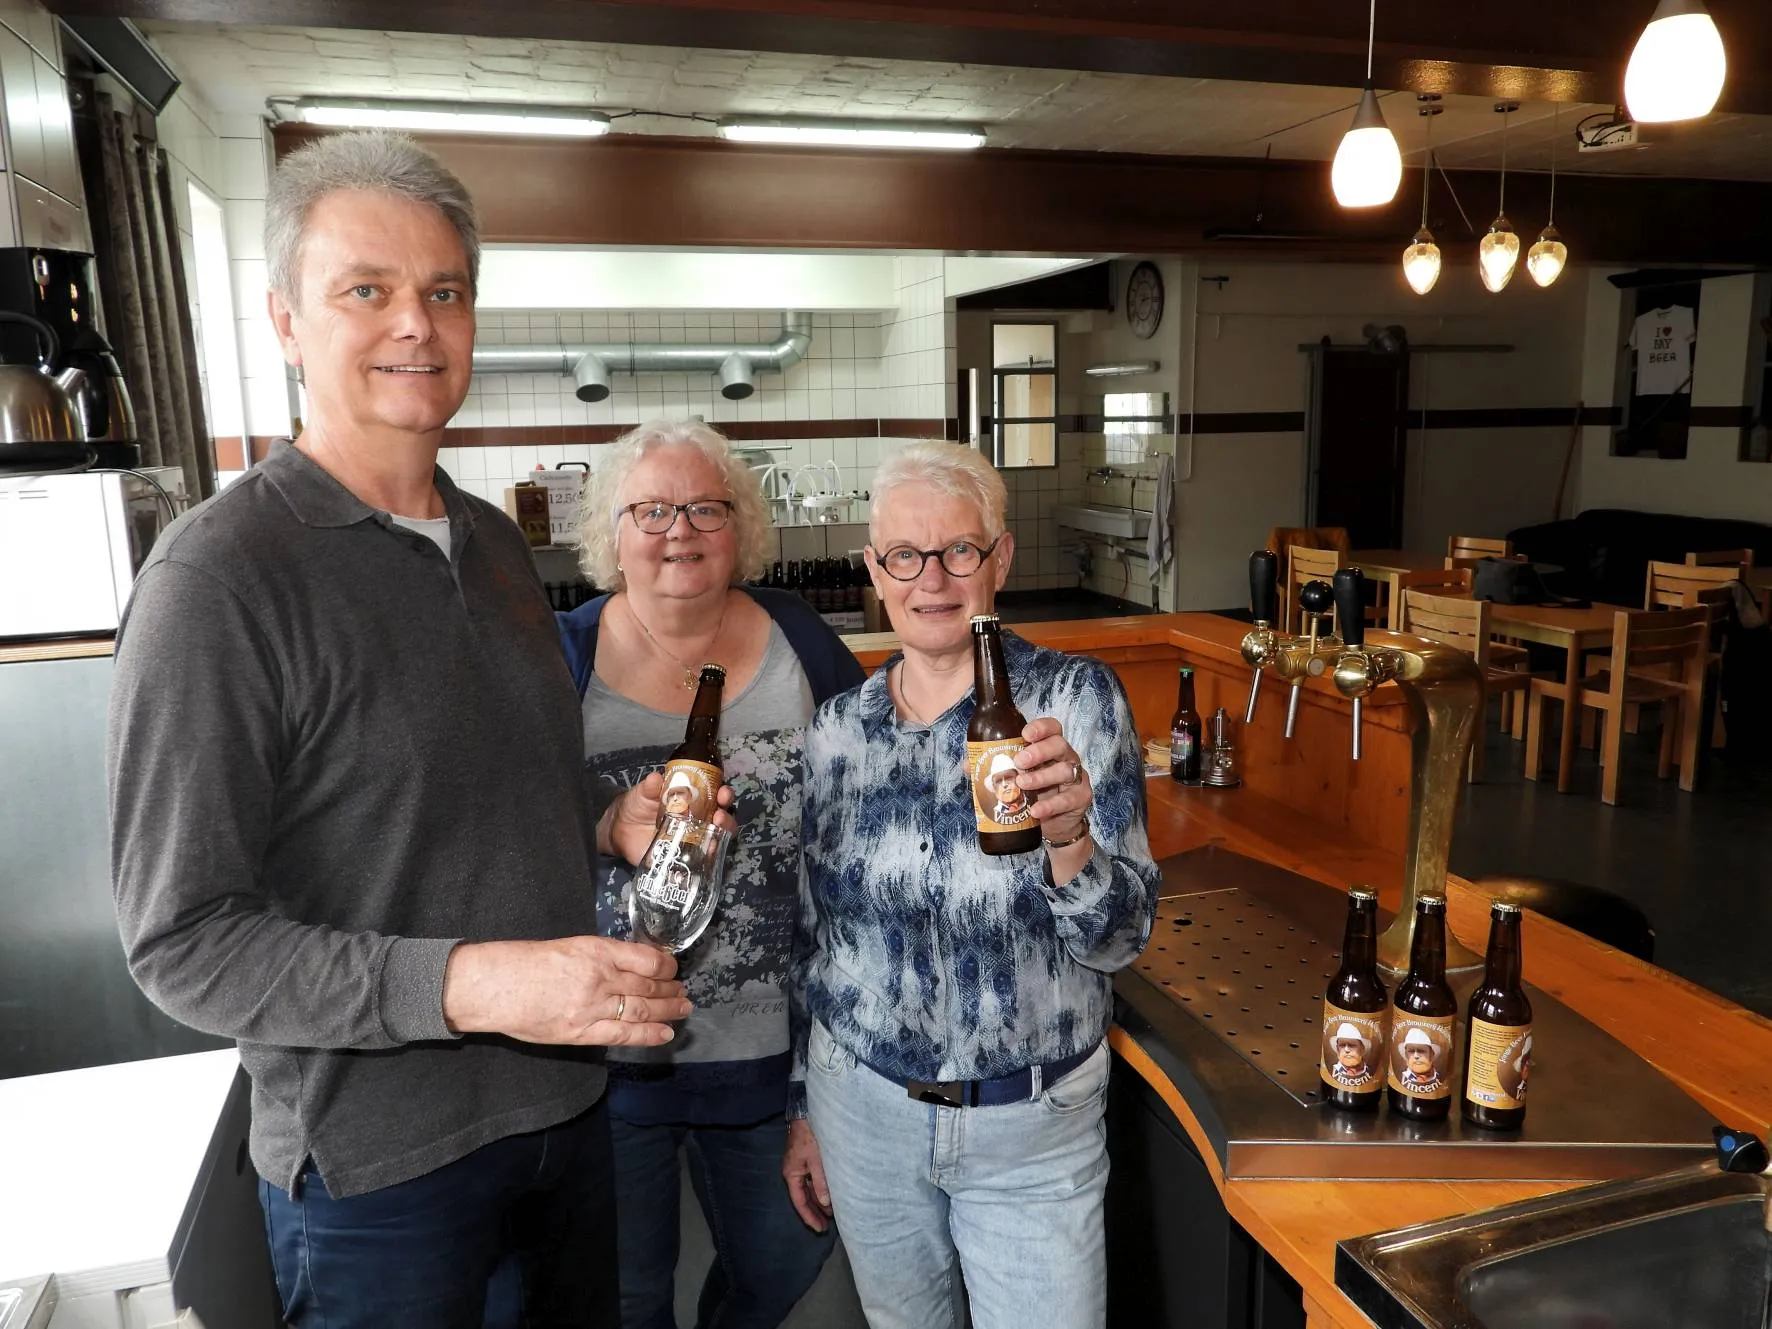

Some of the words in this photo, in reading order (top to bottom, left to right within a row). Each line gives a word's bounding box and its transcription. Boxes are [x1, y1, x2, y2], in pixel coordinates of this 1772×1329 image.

[1655, 327, 1661, 337] I
[1653, 338, 1673, 350] MY
[994, 804, 1031, 825] Vincent
[1332, 1070, 1373, 1087] Vincent
[1400, 1077, 1443, 1093] Vincent
